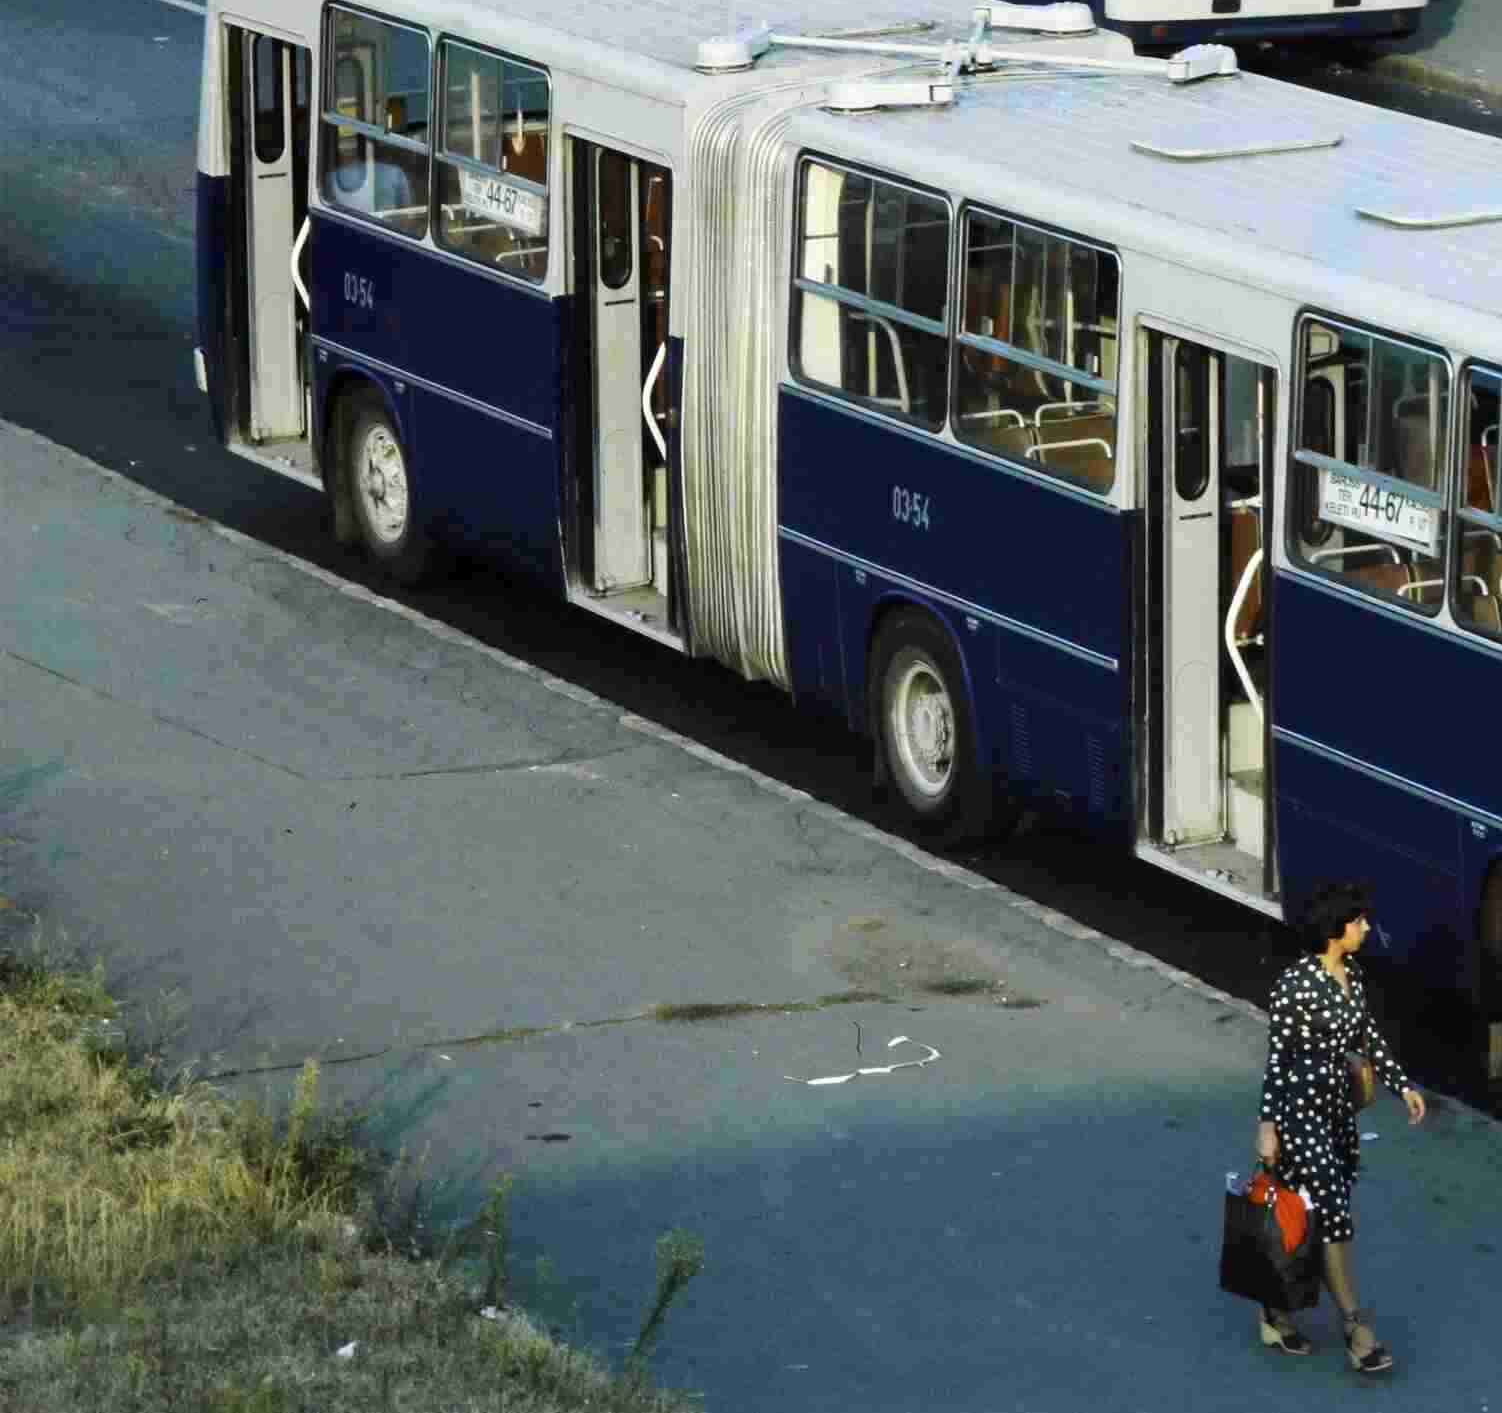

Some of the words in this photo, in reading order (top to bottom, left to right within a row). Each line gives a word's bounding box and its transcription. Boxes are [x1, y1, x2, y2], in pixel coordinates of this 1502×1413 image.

[486, 179, 519, 214] 44-67
[892, 485, 930, 530] 03-54
[1359, 483, 1406, 525] 44-67
